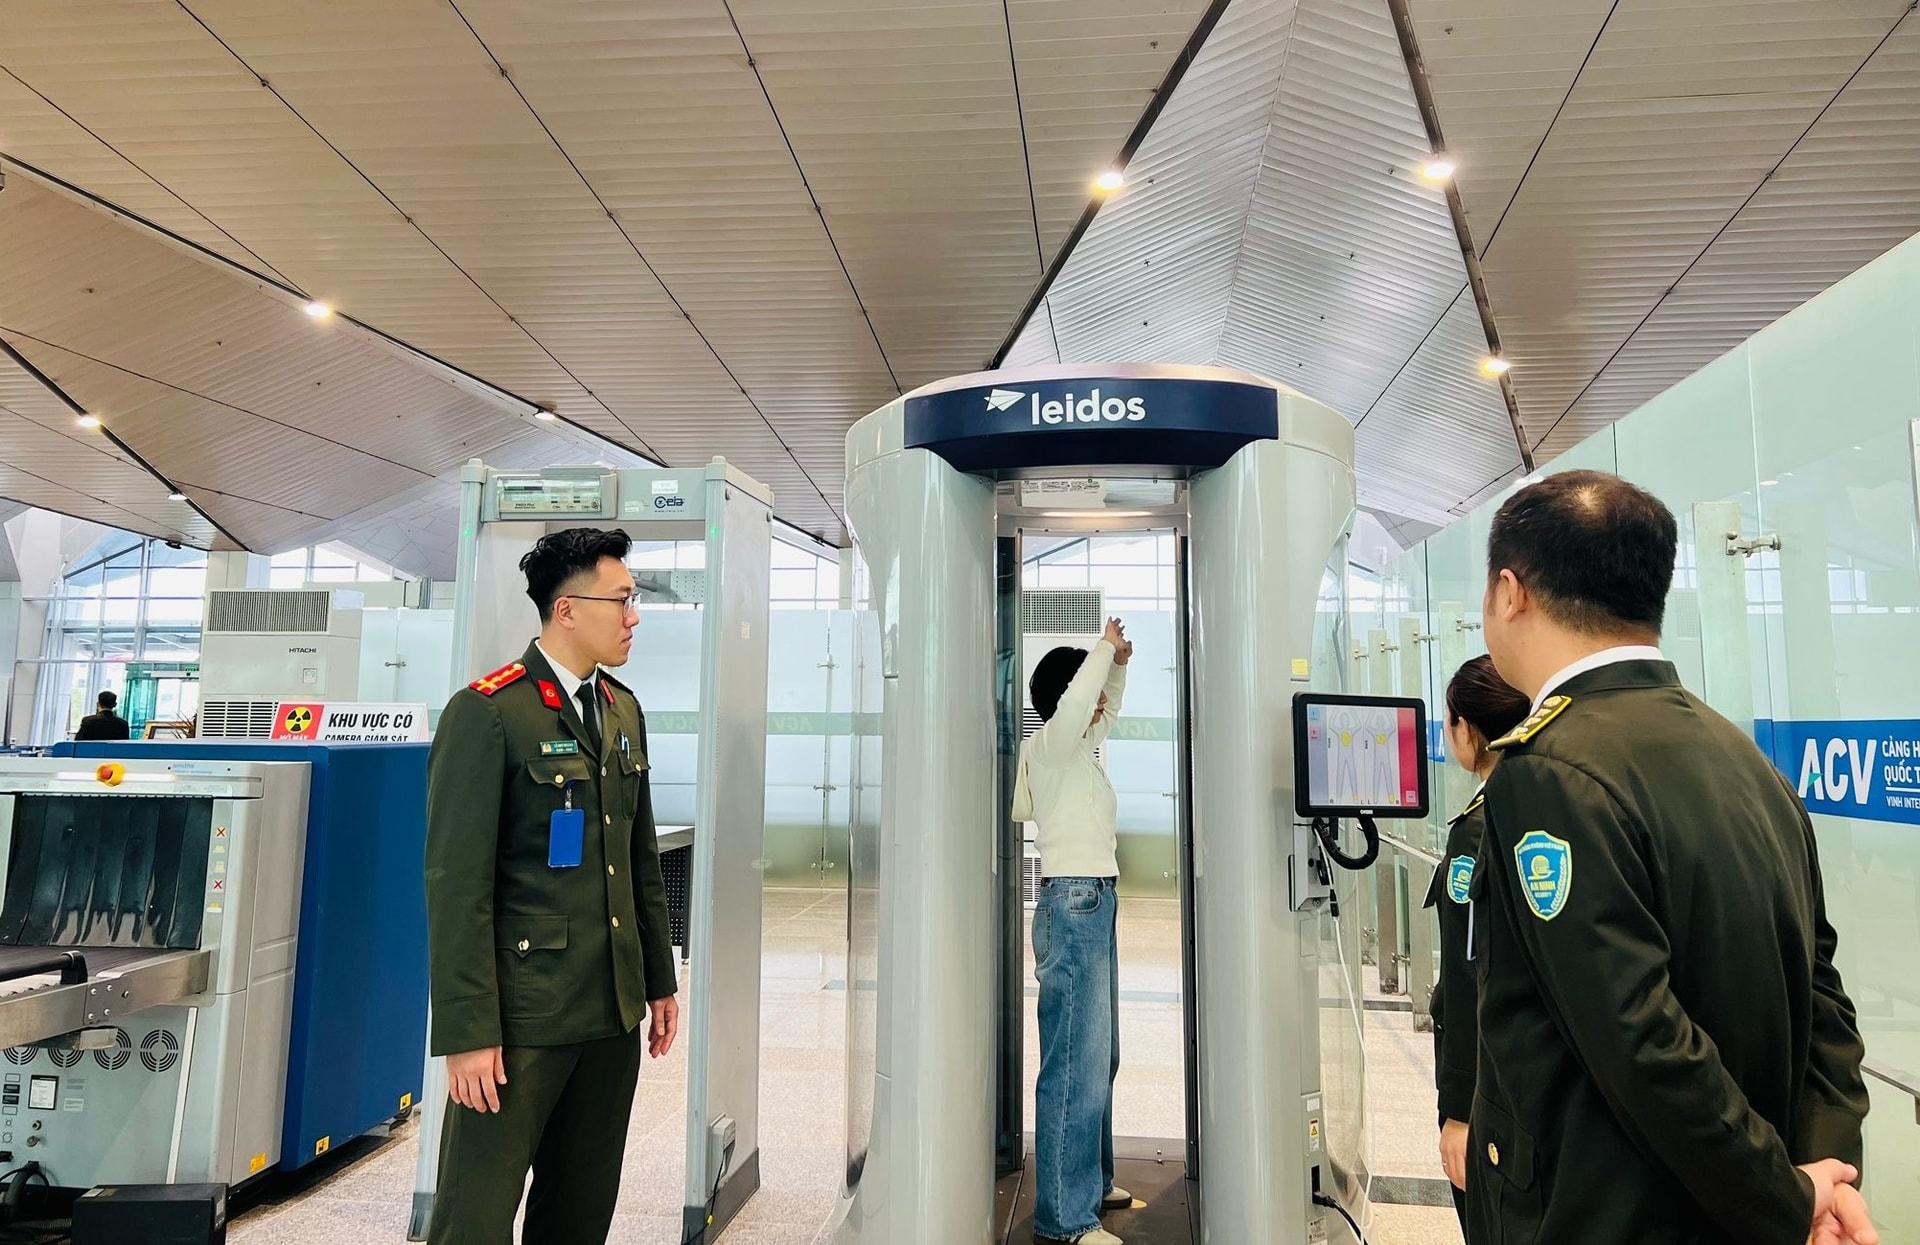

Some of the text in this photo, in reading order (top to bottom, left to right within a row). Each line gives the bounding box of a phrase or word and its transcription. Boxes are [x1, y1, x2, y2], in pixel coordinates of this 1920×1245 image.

[1031, 388, 1146, 425] leidos
[328, 711, 413, 732] KHU VỰC CÓ
[1882, 735, 1911, 758] CẢNG
[1798, 737, 1877, 805] ACV
[1884, 758, 1913, 787] QUỐC
[1886, 795, 1904, 808] VINH
